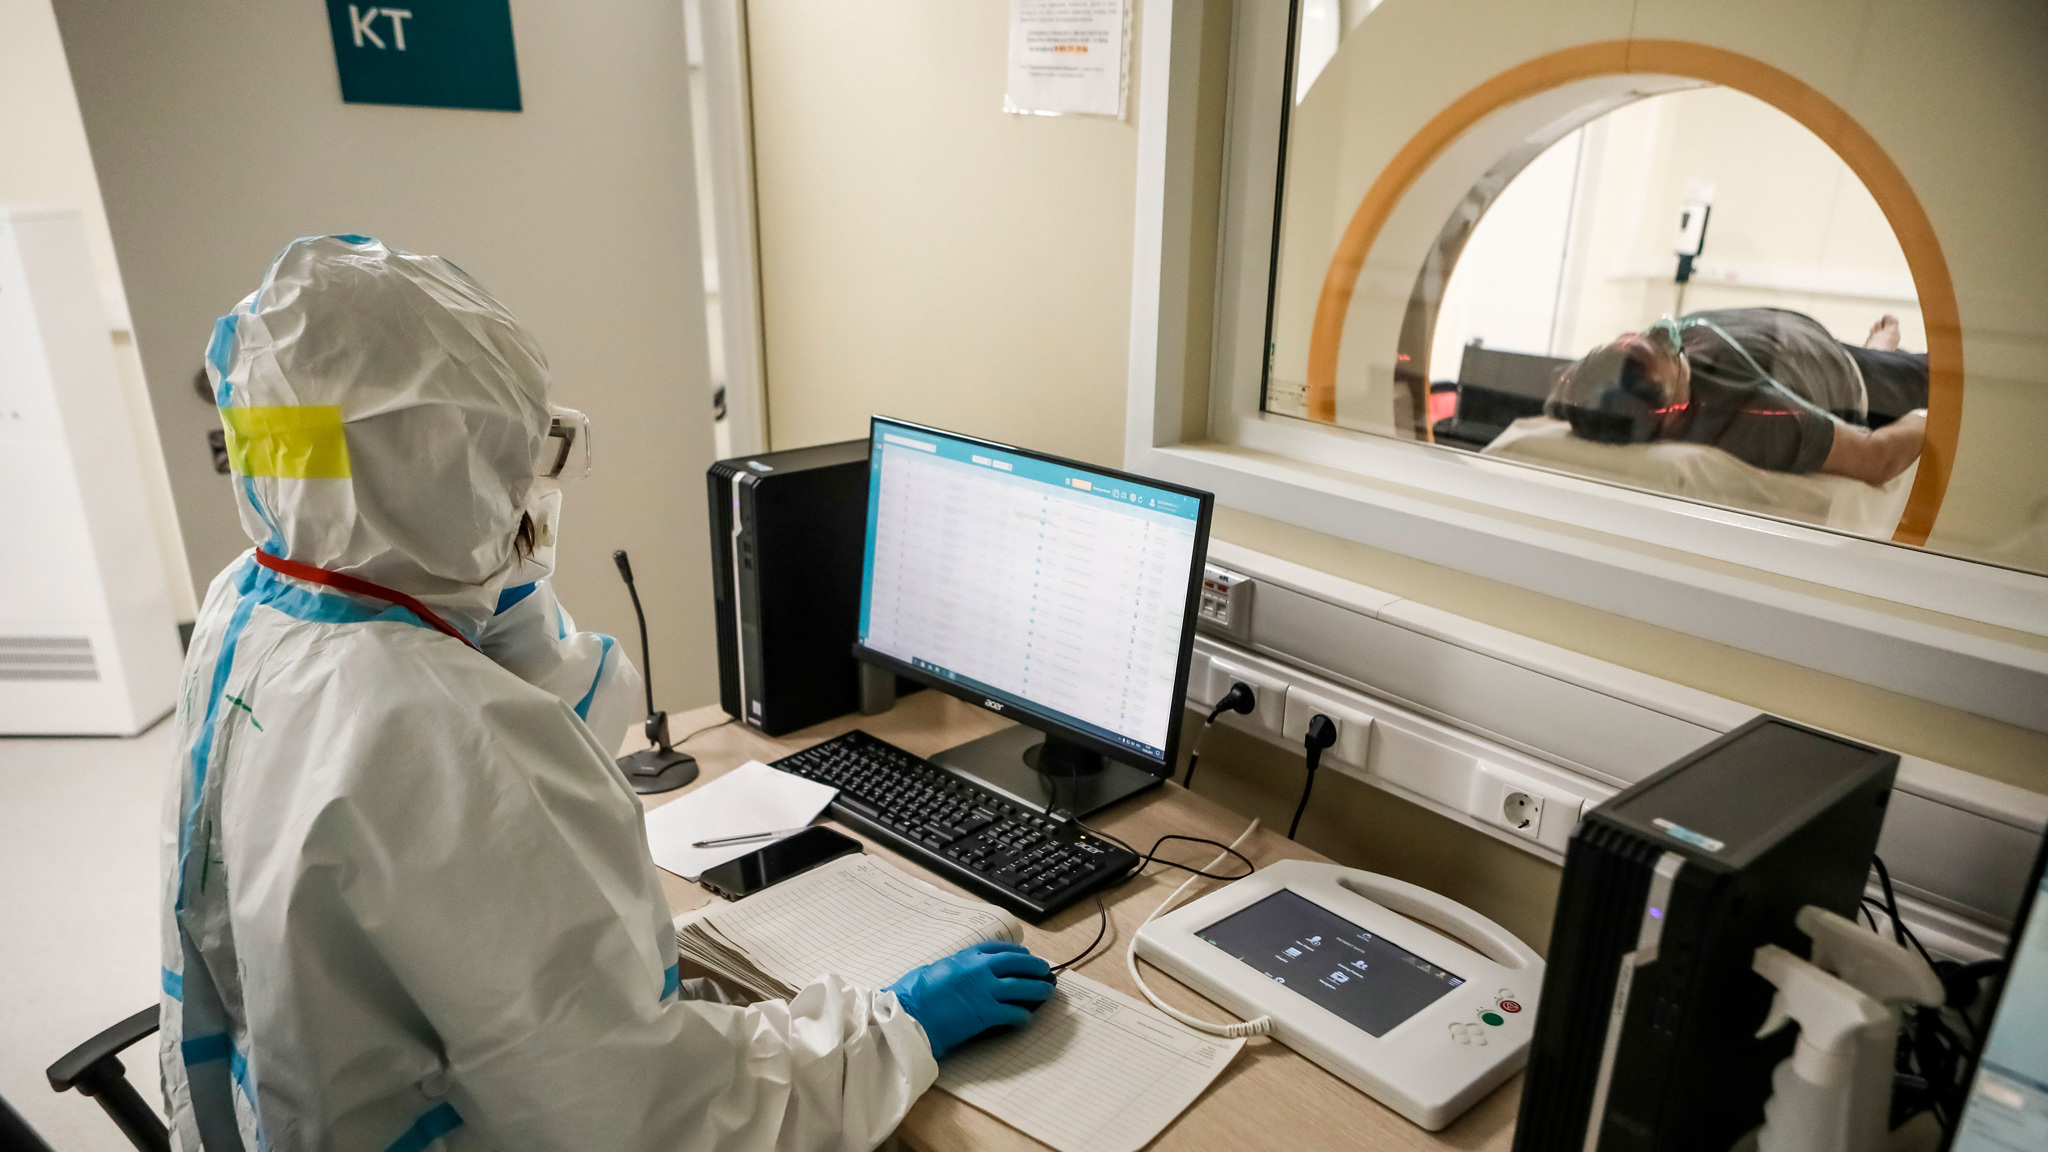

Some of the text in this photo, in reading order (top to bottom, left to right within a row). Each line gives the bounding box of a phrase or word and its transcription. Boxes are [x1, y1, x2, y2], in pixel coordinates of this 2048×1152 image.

[348, 4, 413, 51] KT
[984, 699, 1004, 711] acer
[1074, 841, 1104, 854] acer
